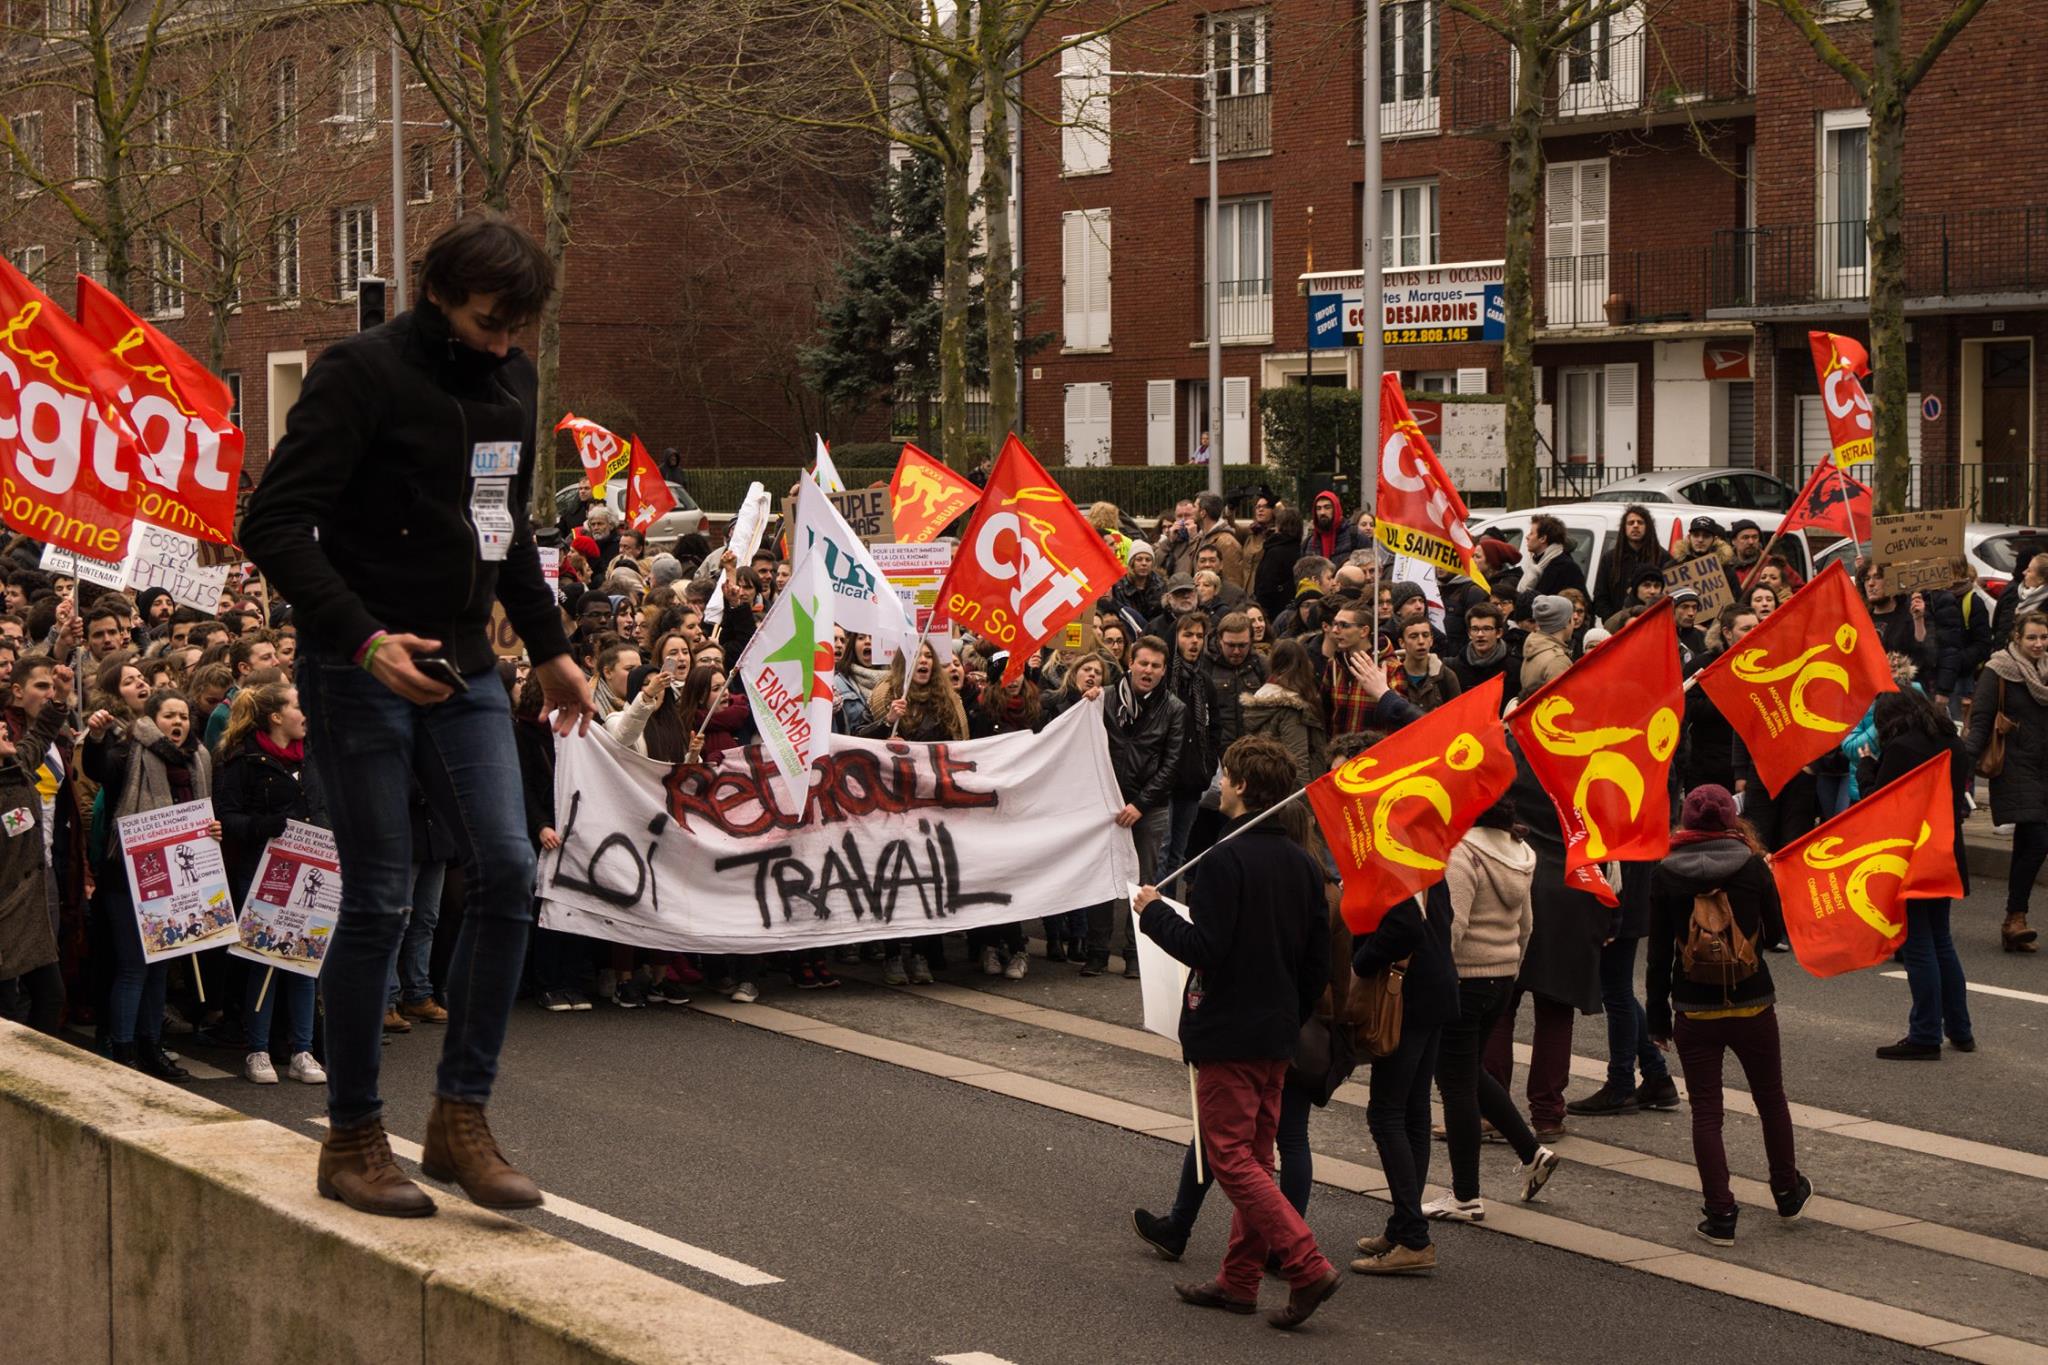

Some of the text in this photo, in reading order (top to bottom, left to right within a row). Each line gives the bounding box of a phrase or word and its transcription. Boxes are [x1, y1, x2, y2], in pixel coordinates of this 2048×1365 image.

[1313, 266, 1505, 292] VOITURE EUVES ET OCCASIO
[1383, 289, 1463, 304] tes Marques
[1315, 304, 1336, 322] IMPORT
[1386, 302, 1478, 325] DESJARDINS
[1317, 317, 1338, 335] EXPORT
[1384, 328, 1469, 344] 03.22.808.145
[831, 492, 884, 519] EUPLE
[849, 516, 881, 536] MAIS
[1386, 527, 1400, 549] UL
[1404, 532, 1464, 570] SANTER
[50, 558, 71, 570] C'EST
[159, 552, 189, 574] DES
[1694, 556, 1720, 576] UN
[132, 558, 221, 608] PEUPLES
[832, 582, 869, 600] dicat
[1693, 574, 1724, 596] SANS
[948, 593, 982, 622] en
[121, 820, 139, 828] POUR
[149, 811, 174, 821] RETRAIT
[123, 828, 133, 836] DE
[143, 824, 153, 832] LOI
[155, 821, 162, 829] EL
[163, 816, 188, 826] KHOMRI
[195, 817, 214, 826] MARS
[304, 829, 328, 841] RETRAIT
[313, 840, 337, 851] KHOMR
